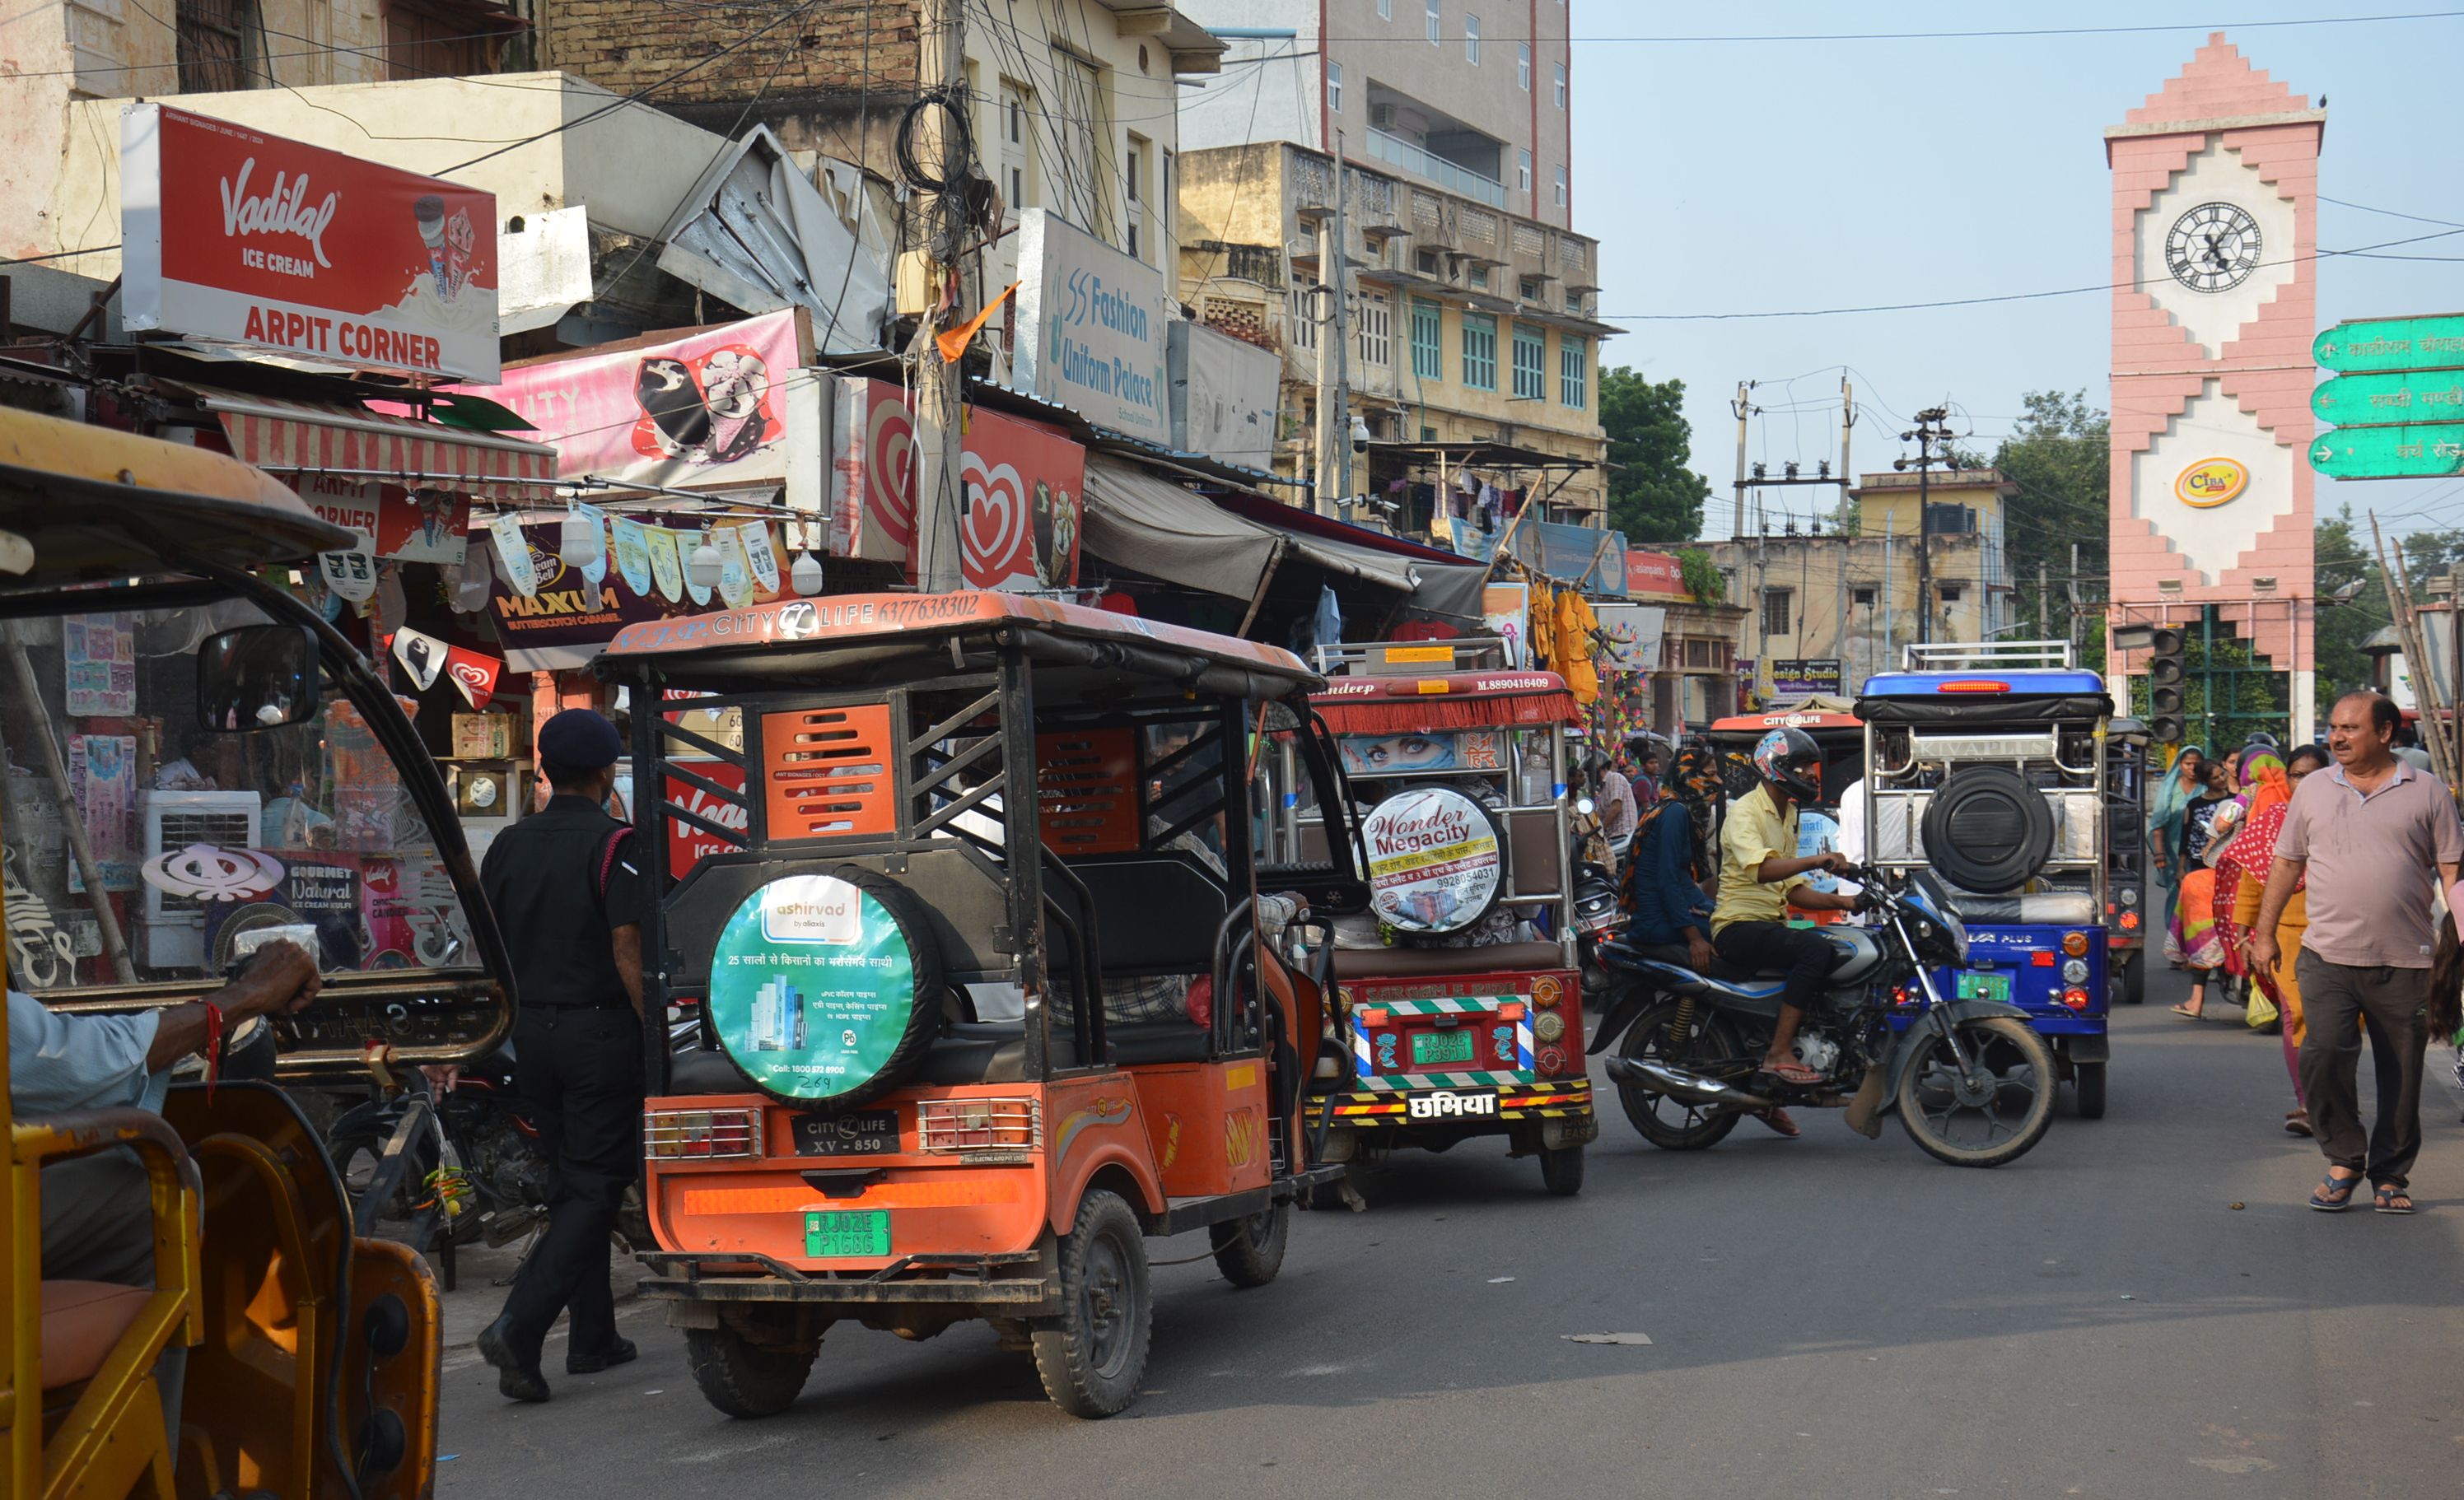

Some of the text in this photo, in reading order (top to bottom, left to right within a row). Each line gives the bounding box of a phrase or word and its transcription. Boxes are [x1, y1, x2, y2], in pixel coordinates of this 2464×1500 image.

[220, 157, 337, 268] Vadilal
[243, 248, 315, 278] ICE CREAM
[1091, 276, 1148, 343] Fashion
[244, 305, 442, 370] ARPIT CORNER
[2349, 335, 2412, 356] काशीराम
[1062, 337, 1152, 408] Uniform Palace
[2368, 387, 2412, 409] सब्जी
[310, 505, 375, 538] ORNER
[506, 613, 623, 631] BUTTERSCOTCH CARAMEL
[712, 611, 776, 636] CITY
[820, 603, 875, 627] LIFE
[878, 594, 979, 624] 6377638302
[1773, 667, 1801, 682] esign
[1804, 667, 1839, 682] Studio
[1477, 678, 1549, 692] M.8890416409
[1763, 715, 1821, 725] CITY LIFE
[1370, 795, 1469, 841] Wonder
[1374, 824, 1471, 856] Megacity
[290, 865, 352, 878] GOURMET
[1415, 870, 1422, 880] 3
[1435, 867, 1495, 889] 9928054031
[292, 879, 352, 901] Natural
[304, 901, 329, 910] CREAM
[330, 901, 352, 910] KULFI
[777, 901, 846, 917] ashirvad
[794, 920, 826, 929] by aliaxis
[2000, 934, 2033, 944] PLUS
[728, 955, 740, 966] 25
[768, 953, 778, 967] से
[814, 956, 826, 967] का
[869, 955, 894, 968] साथी
[1366, 982, 1517, 1004] SARGAM E RIDE
[1422, 1034, 1467, 1048] RJ02E
[1425, 1046, 1468, 1061] P3911
[791, 1064, 812, 1073] 1800
[1408, 1091, 1497, 1118] छमिया
[807, 1122, 836, 1134] CITY
[861, 1120, 886, 1132] LIFE
[854, 1139, 881, 1151] 850
[819, 1212, 873, 1233] RJ02E
